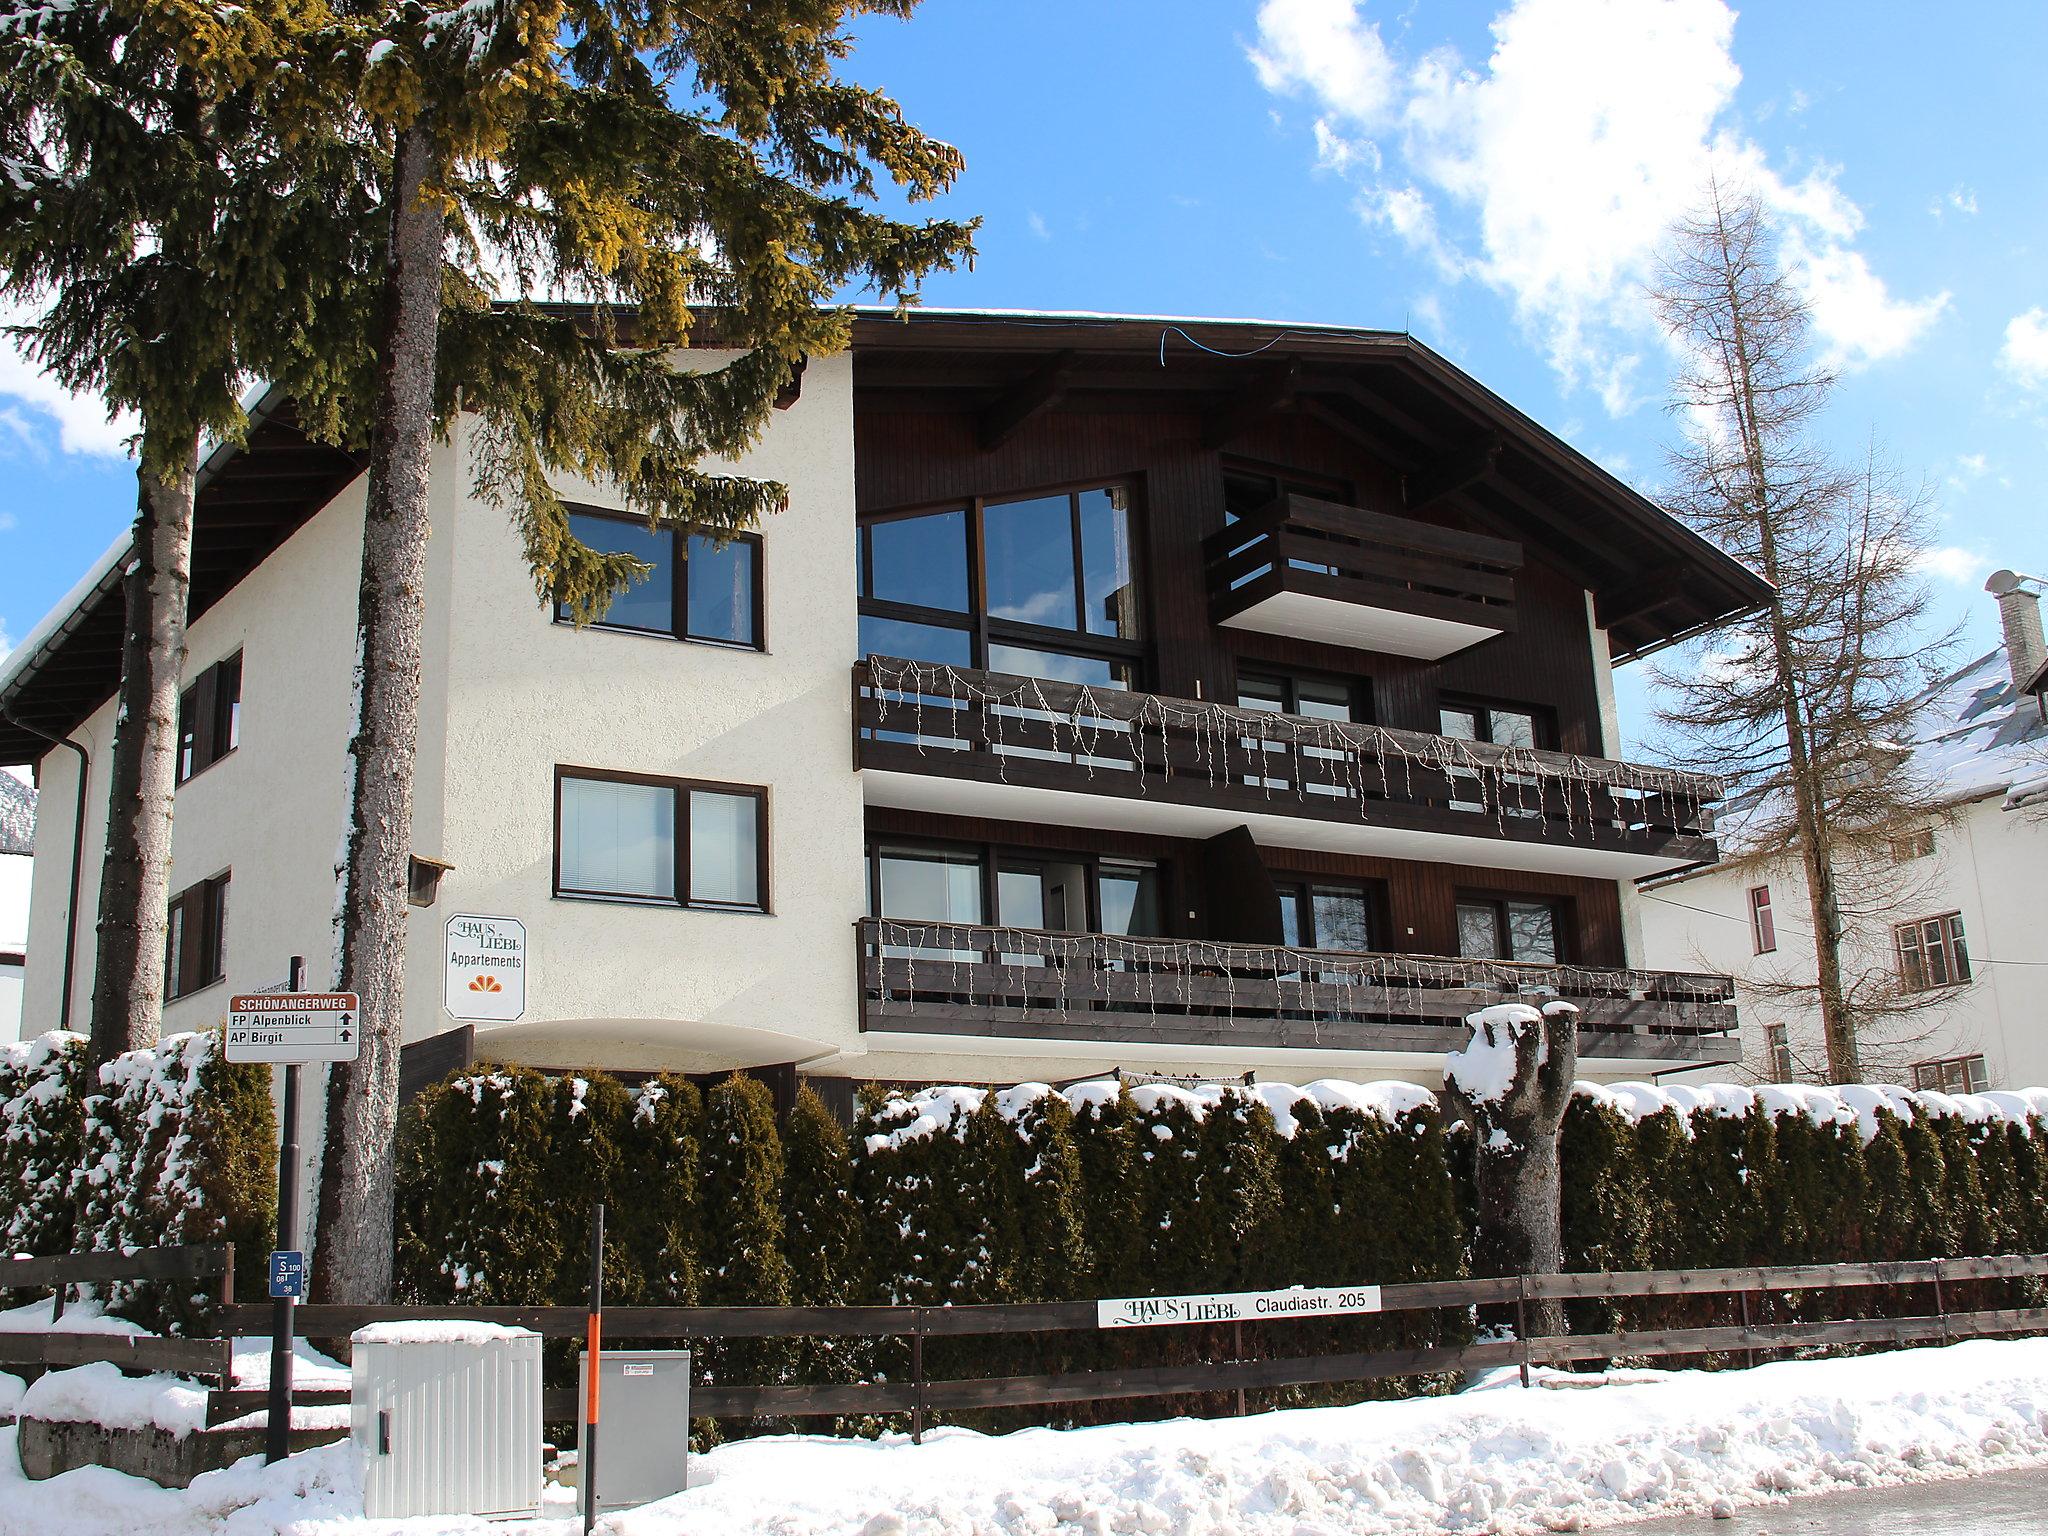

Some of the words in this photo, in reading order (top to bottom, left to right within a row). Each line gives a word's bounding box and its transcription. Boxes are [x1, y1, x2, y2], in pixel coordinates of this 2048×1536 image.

[449, 922, 496, 939] HAUS
[477, 933, 522, 951] LIEBL
[451, 951, 522, 969] Appartements
[239, 996, 347, 1011] SCHÖNANGERWEG
[232, 1015, 247, 1026] FP
[252, 1014, 311, 1027] Alpenblick
[230, 1032, 247, 1043] AP
[251, 1032, 283, 1045] Birgit
[280, 1261, 287, 1272] S
[289, 1264, 301, 1272] 100
[1113, 1299, 1179, 1324] HAUS
[1180, 1297, 1241, 1321] LIEBL
[1255, 1296, 1333, 1313] Claudiastr.
[1338, 1292, 1366, 1308] 205
